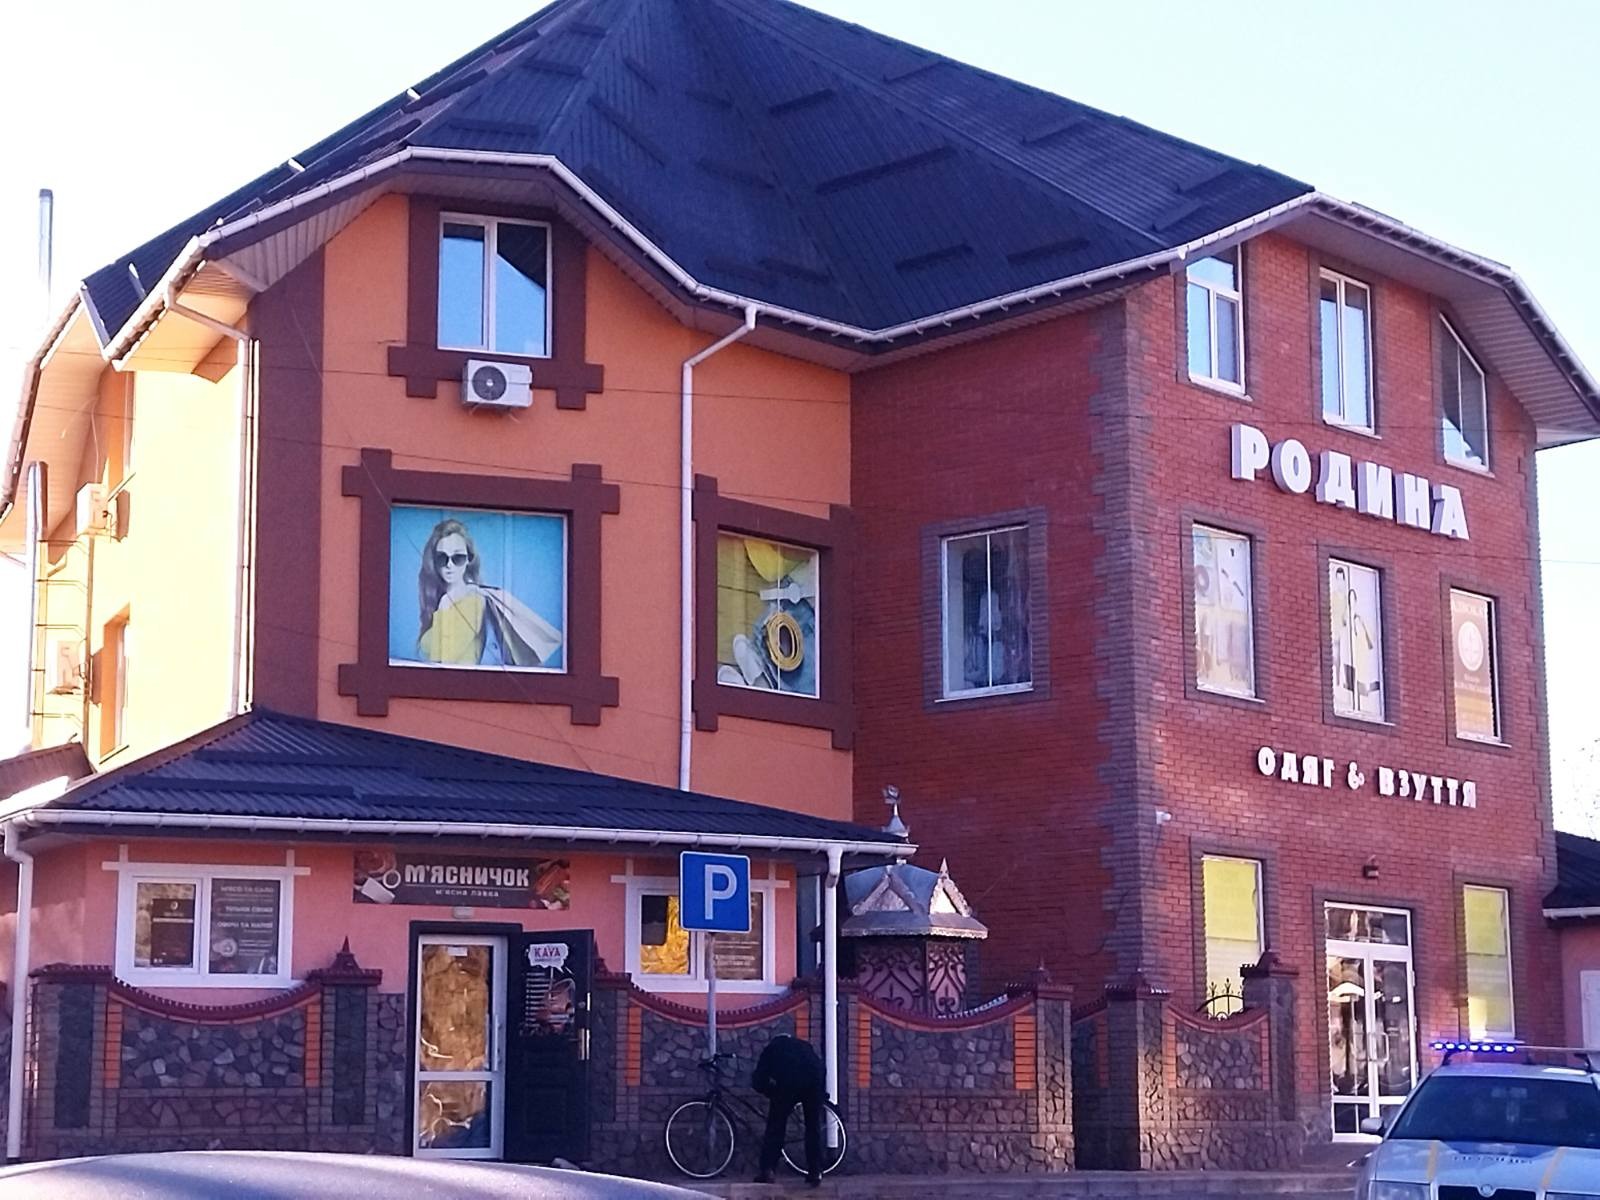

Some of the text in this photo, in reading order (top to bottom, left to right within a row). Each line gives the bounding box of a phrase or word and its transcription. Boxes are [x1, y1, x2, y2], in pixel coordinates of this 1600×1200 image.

[1232, 423, 1470, 541] РОДИНА
[1257, 746, 1477, 809] ОДЯГ & ВЗУТТЯ
[405, 864, 529, 887] М'ЯСНИЧОК
[704, 864, 738, 920] P
